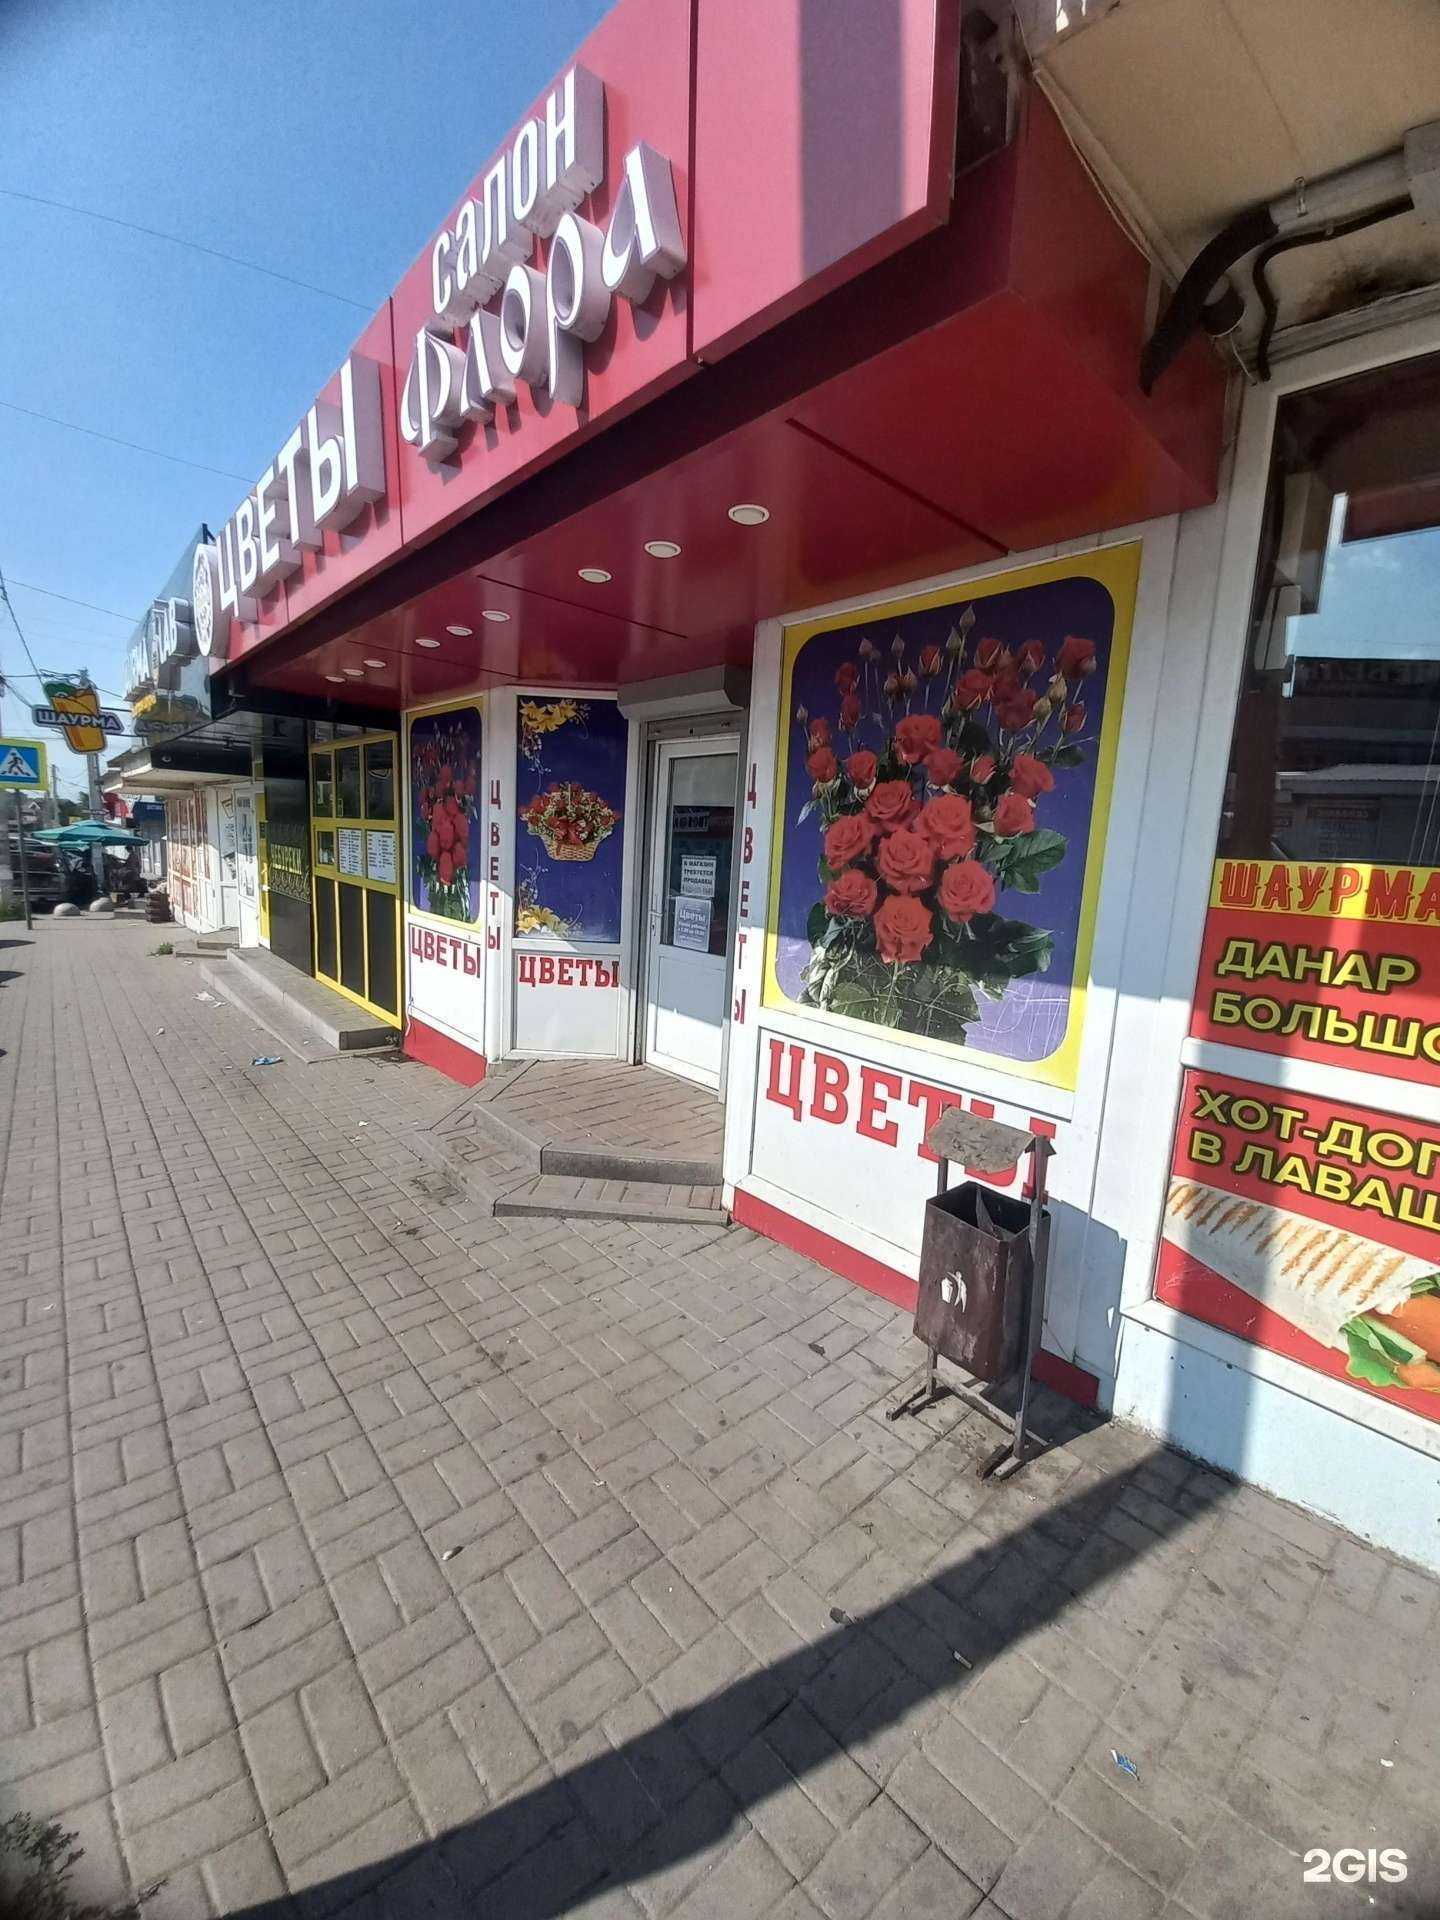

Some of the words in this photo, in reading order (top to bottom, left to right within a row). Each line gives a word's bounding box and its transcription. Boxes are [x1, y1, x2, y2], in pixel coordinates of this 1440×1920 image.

[216, 357, 360, 618] ЦВЕТЫ
[37, 709, 119, 730] ШАУРМА
[1219, 861, 1440, 921] ШАУРМА
[411, 926, 481, 978] ЦВЕТЫ
[518, 955, 620, 988] ЦВЕТЫ
[1216, 939, 1417, 992] ДАНАР
[1190, 1130, 1223, 1165] В
